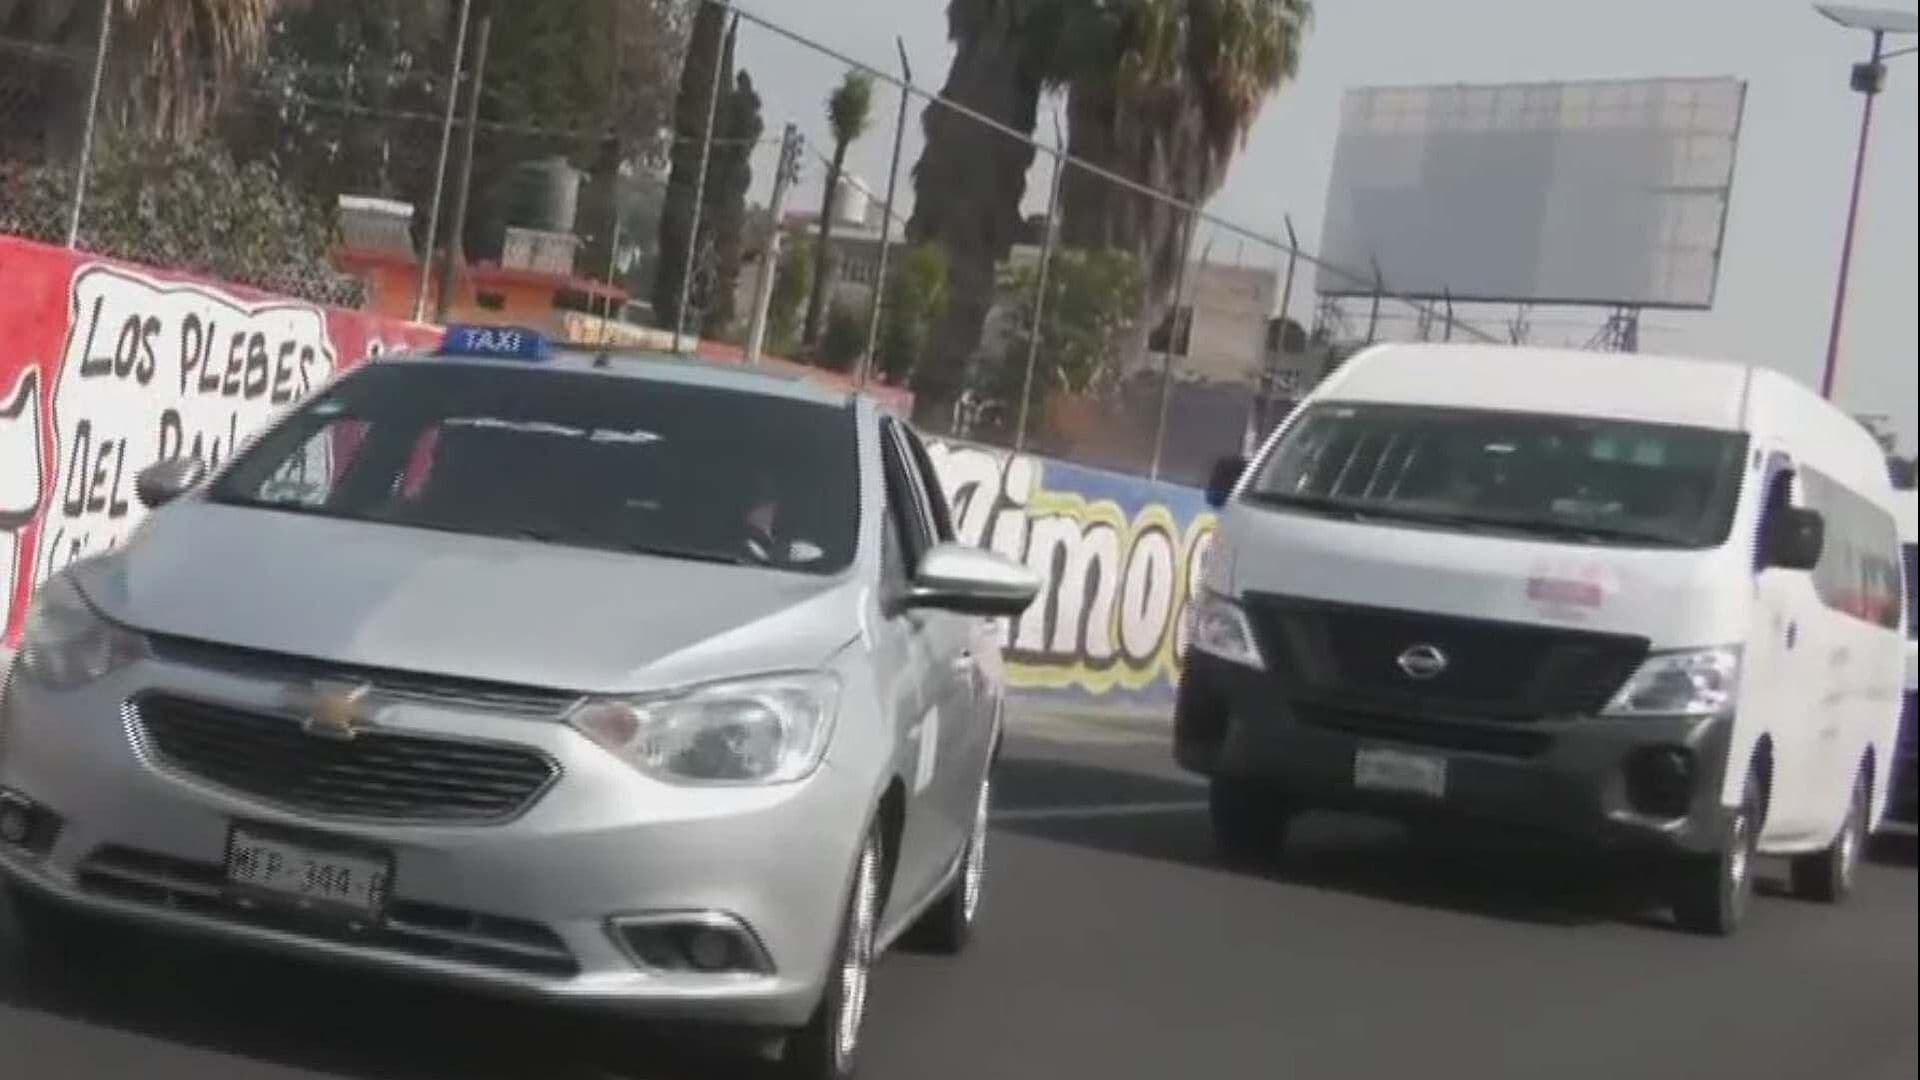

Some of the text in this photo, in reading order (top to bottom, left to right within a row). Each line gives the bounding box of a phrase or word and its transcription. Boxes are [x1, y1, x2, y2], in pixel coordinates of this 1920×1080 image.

[79, 294, 315, 405] LOS PLEBES
[464, 328, 522, 353] TAXI
[62, 418, 129, 518] DEL
